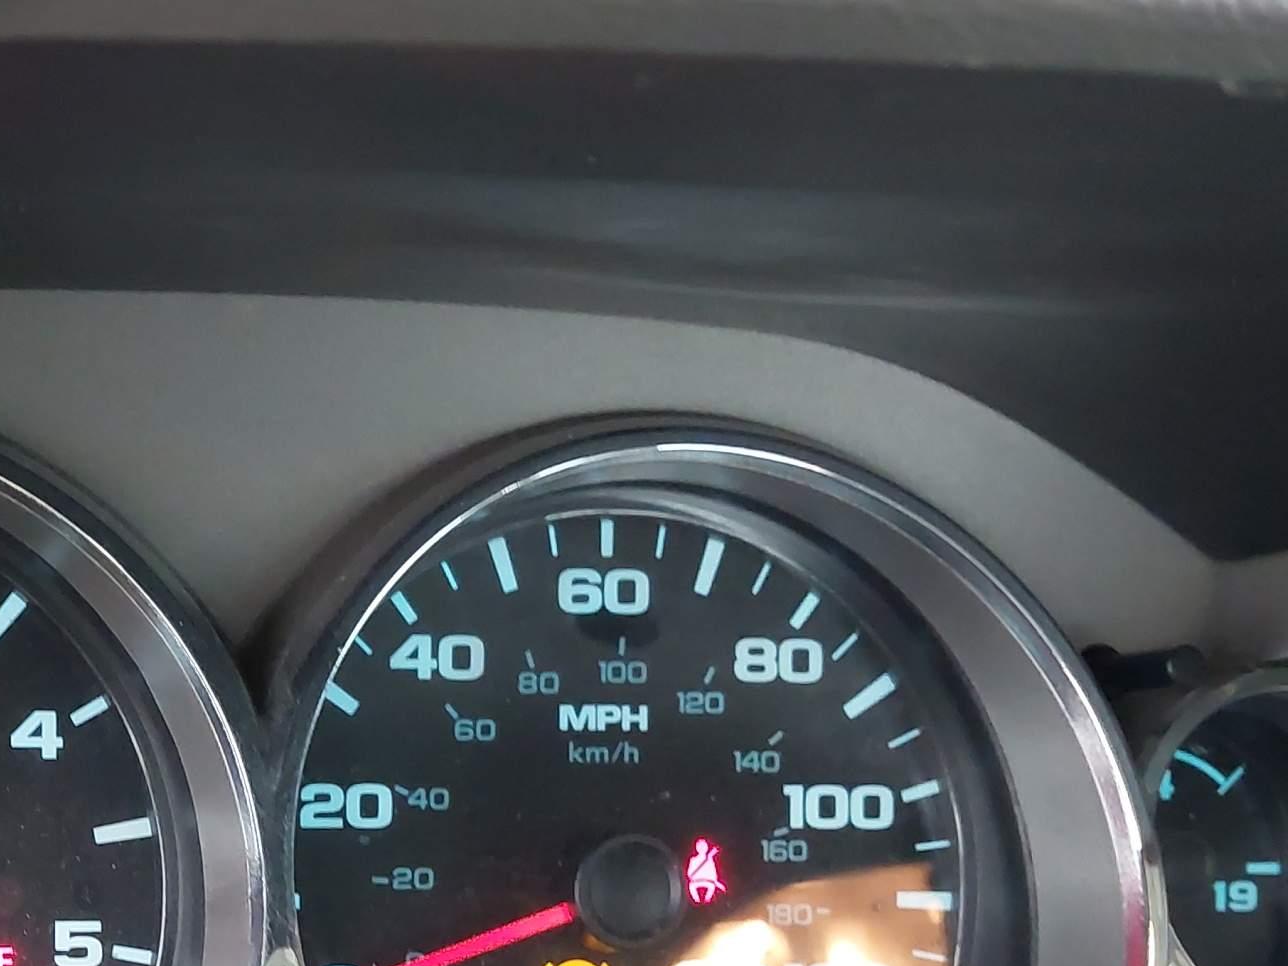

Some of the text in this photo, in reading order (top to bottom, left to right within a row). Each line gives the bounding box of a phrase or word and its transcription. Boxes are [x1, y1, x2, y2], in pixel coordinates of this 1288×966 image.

[558, 568, 650, 615] 60
[389, 634, 485, 681] 40
[734, 637, 823, 684] 80
[518, 671, 559, 695] 80
[598, 660, 647, 684] 100
[677, 691, 725, 715] 120
[454, 719, 496, 742] 60
[559, 705, 649, 732] MPH
[10, 709, 64, 759] 4
[568, 742, 640, 765] km/h
[733, 750, 781, 774] 140
[300, 783, 393, 830] 20
[407, 787, 450, 811] 40
[783, 784, 895, 830] 100
[761, 839, 808, 863] 160
[391, 867, 434, 891] 20
[1213, 879, 1258, 912] 19
[767, 904, 813, 925] 180
